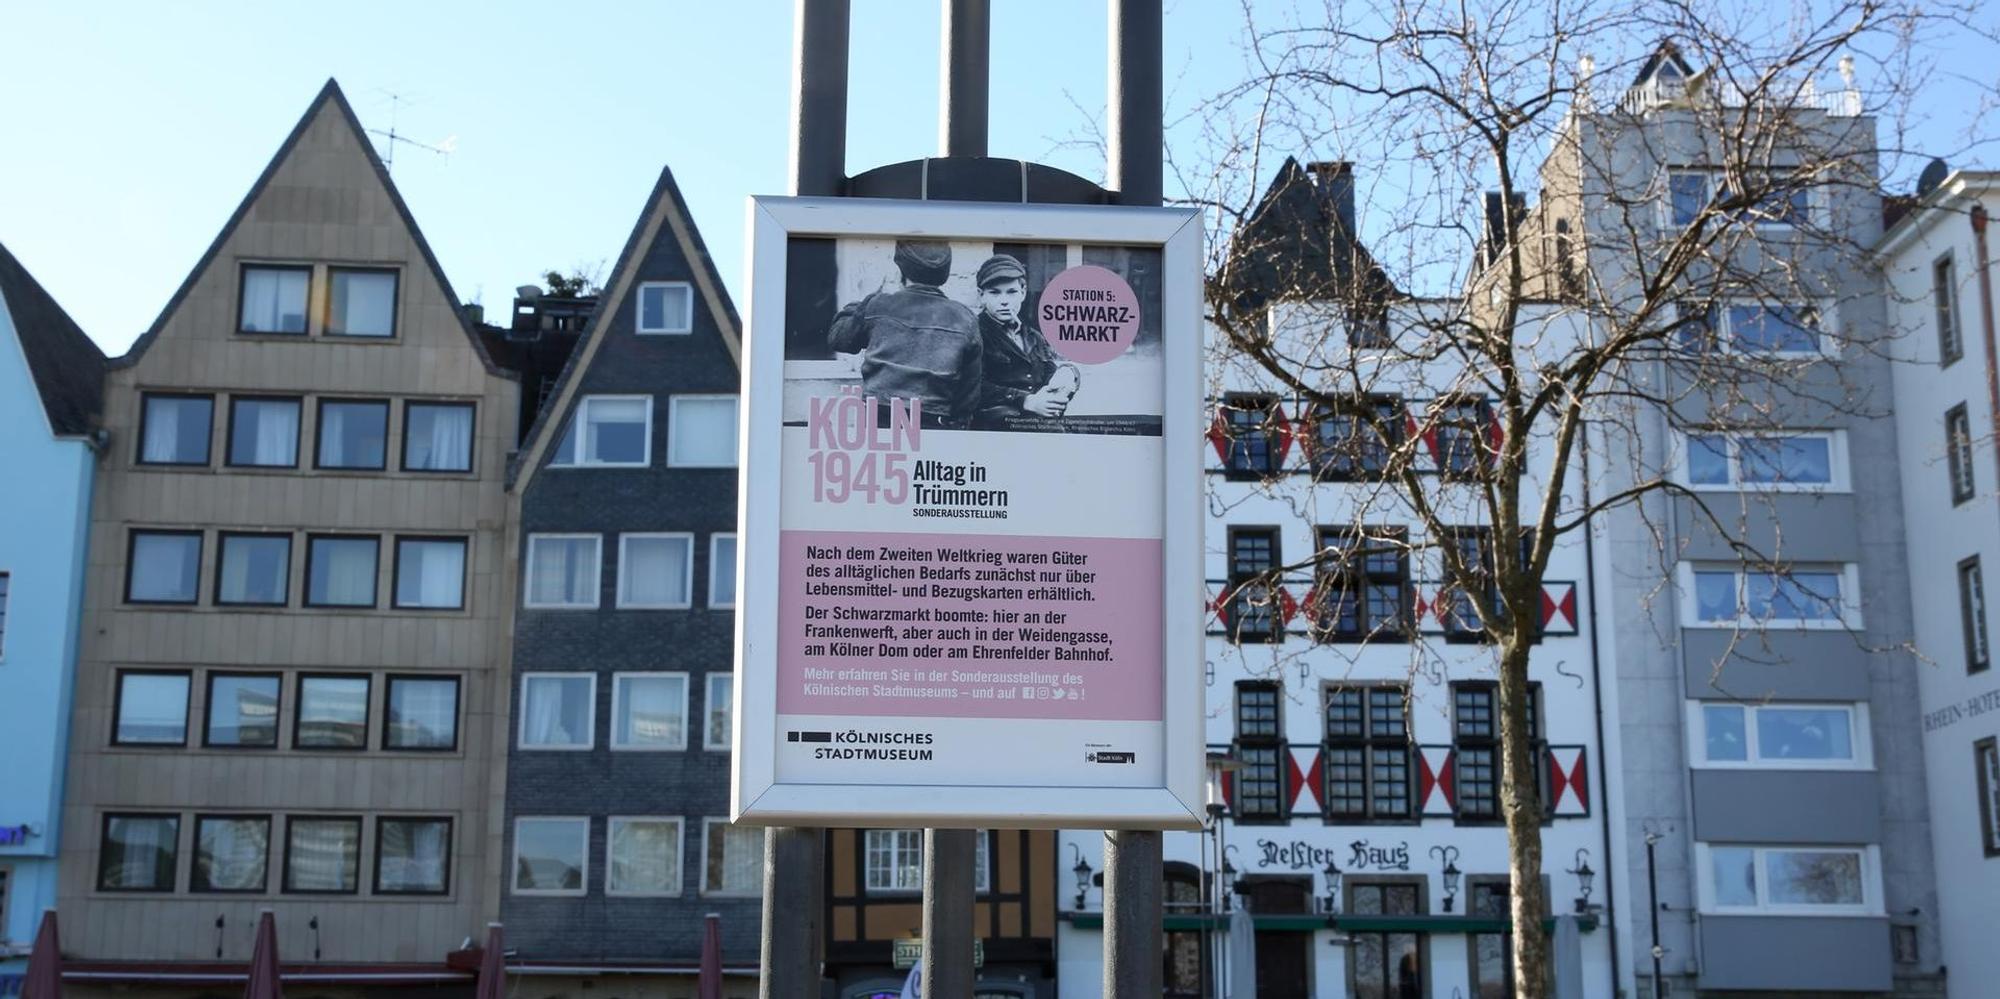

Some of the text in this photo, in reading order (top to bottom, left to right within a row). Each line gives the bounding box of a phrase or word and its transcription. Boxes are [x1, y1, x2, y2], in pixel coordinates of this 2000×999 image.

[1063, 290, 1115, 302] STATION 5:
[1043, 305, 1135, 323] SCHWARZ-
[1059, 325, 1120, 342] MARKT
[807, 385, 921, 452] KÖLN
[807, 451, 909, 505] 1945
[913, 460, 986, 486] Alltag in
[913, 483, 1007, 506] Trümmern
[913, 508, 1007, 519] SONDERAUSSTELLUNG
[807, 546, 1088, 566] Nach dem Zweiten Weltkrieg waren Güter
[807, 564, 1096, 583] des alltäglichen Bedarfs zunächst nur über
[806, 582, 1095, 601] Lebensmittel- und Bezugskarten erhältlich.
[806, 606, 1066, 624] Der Schwarzmarkt boomte: hier an der
[805, 624, 1112, 646] Frankenwerft, aber auch in der Weidengasse,
[805, 643, 1113, 661] am Kölner Dom oder am Ehrenfelder Bahnhof.
[805, 668, 1083, 686] Mehr erfahren Sie in der Sonderausstellung des
[804, 683, 869, 696] Kölnischen
[873, 685, 958, 697] Stadtmuseums
[973, 687, 993, 698] und
[997, 687, 1016, 699] auf
[836, 730, 933, 744] KÖLNISCHES
[815, 748, 932, 760] STADTMUSEUM
[1348, 839, 1409, 870] Haus
